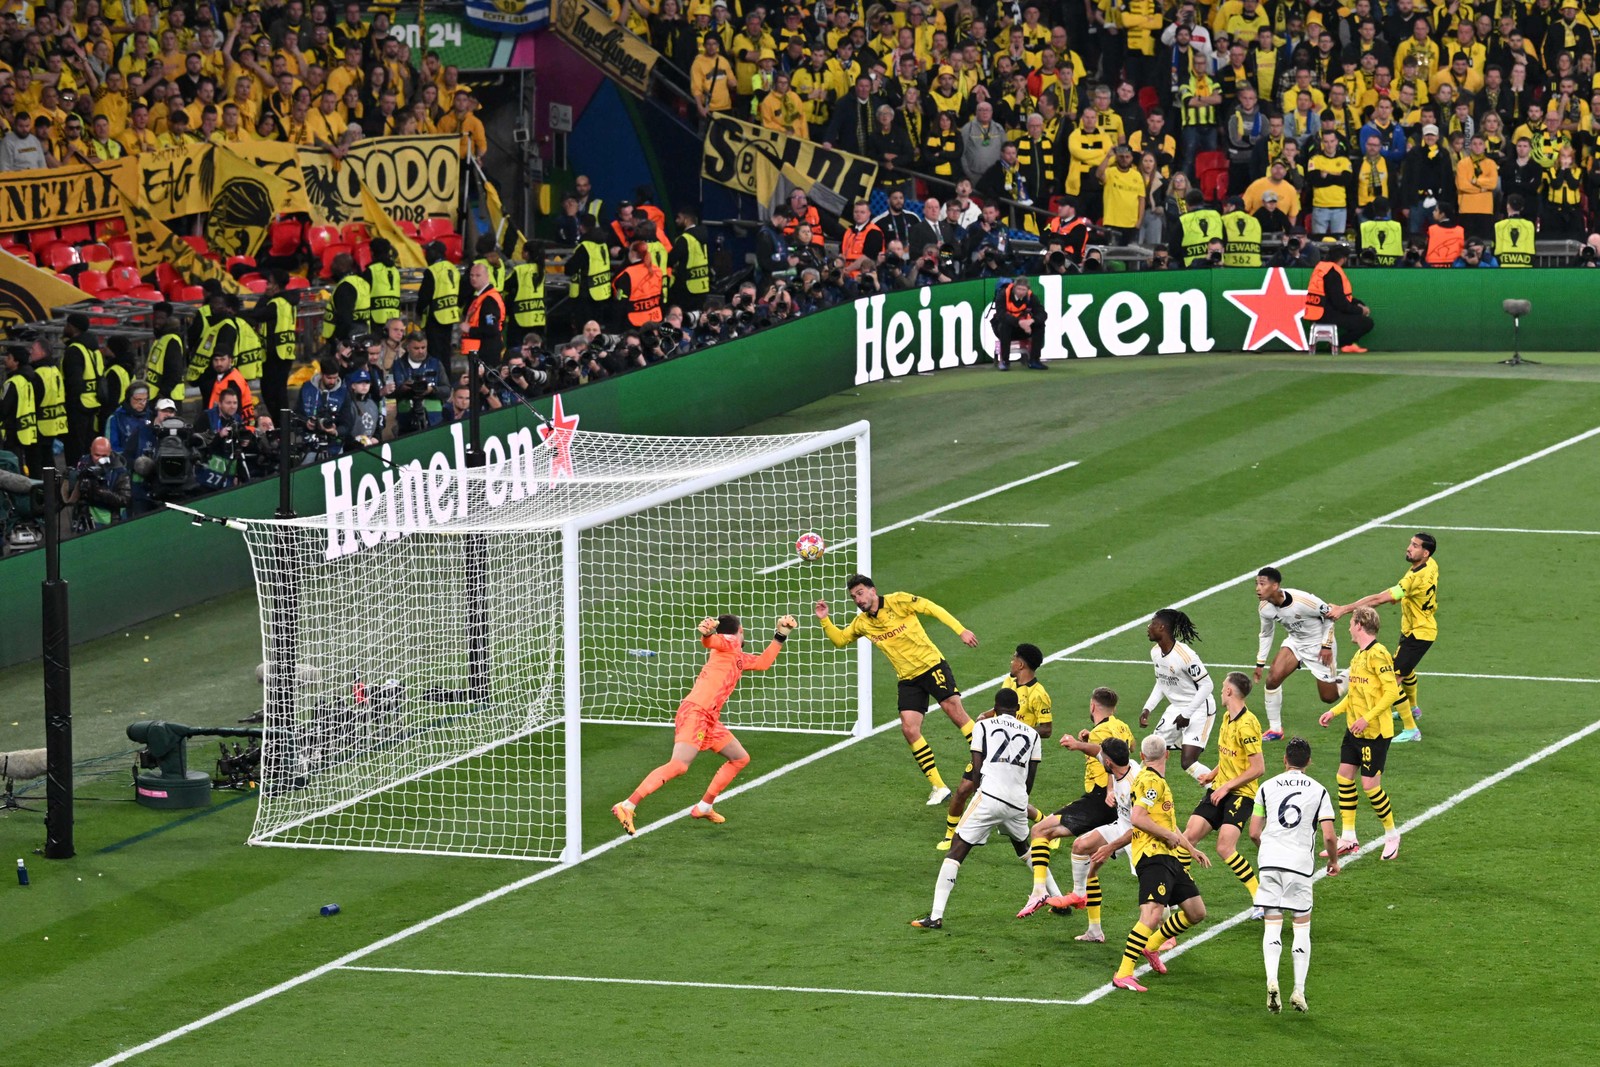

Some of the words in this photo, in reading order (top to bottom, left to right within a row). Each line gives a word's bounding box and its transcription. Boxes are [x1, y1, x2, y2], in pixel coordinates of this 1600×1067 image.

[428, 23, 462, 48] 24
[0, 173, 120, 223] NETAL
[1232, 254, 1251, 265] 362
[931, 669, 946, 686] 15
[990, 728, 1031, 769] 22
[1276, 779, 1311, 787] NACHO
[1233, 796, 1243, 810] 4
[1278, 791, 1302, 829] 6
